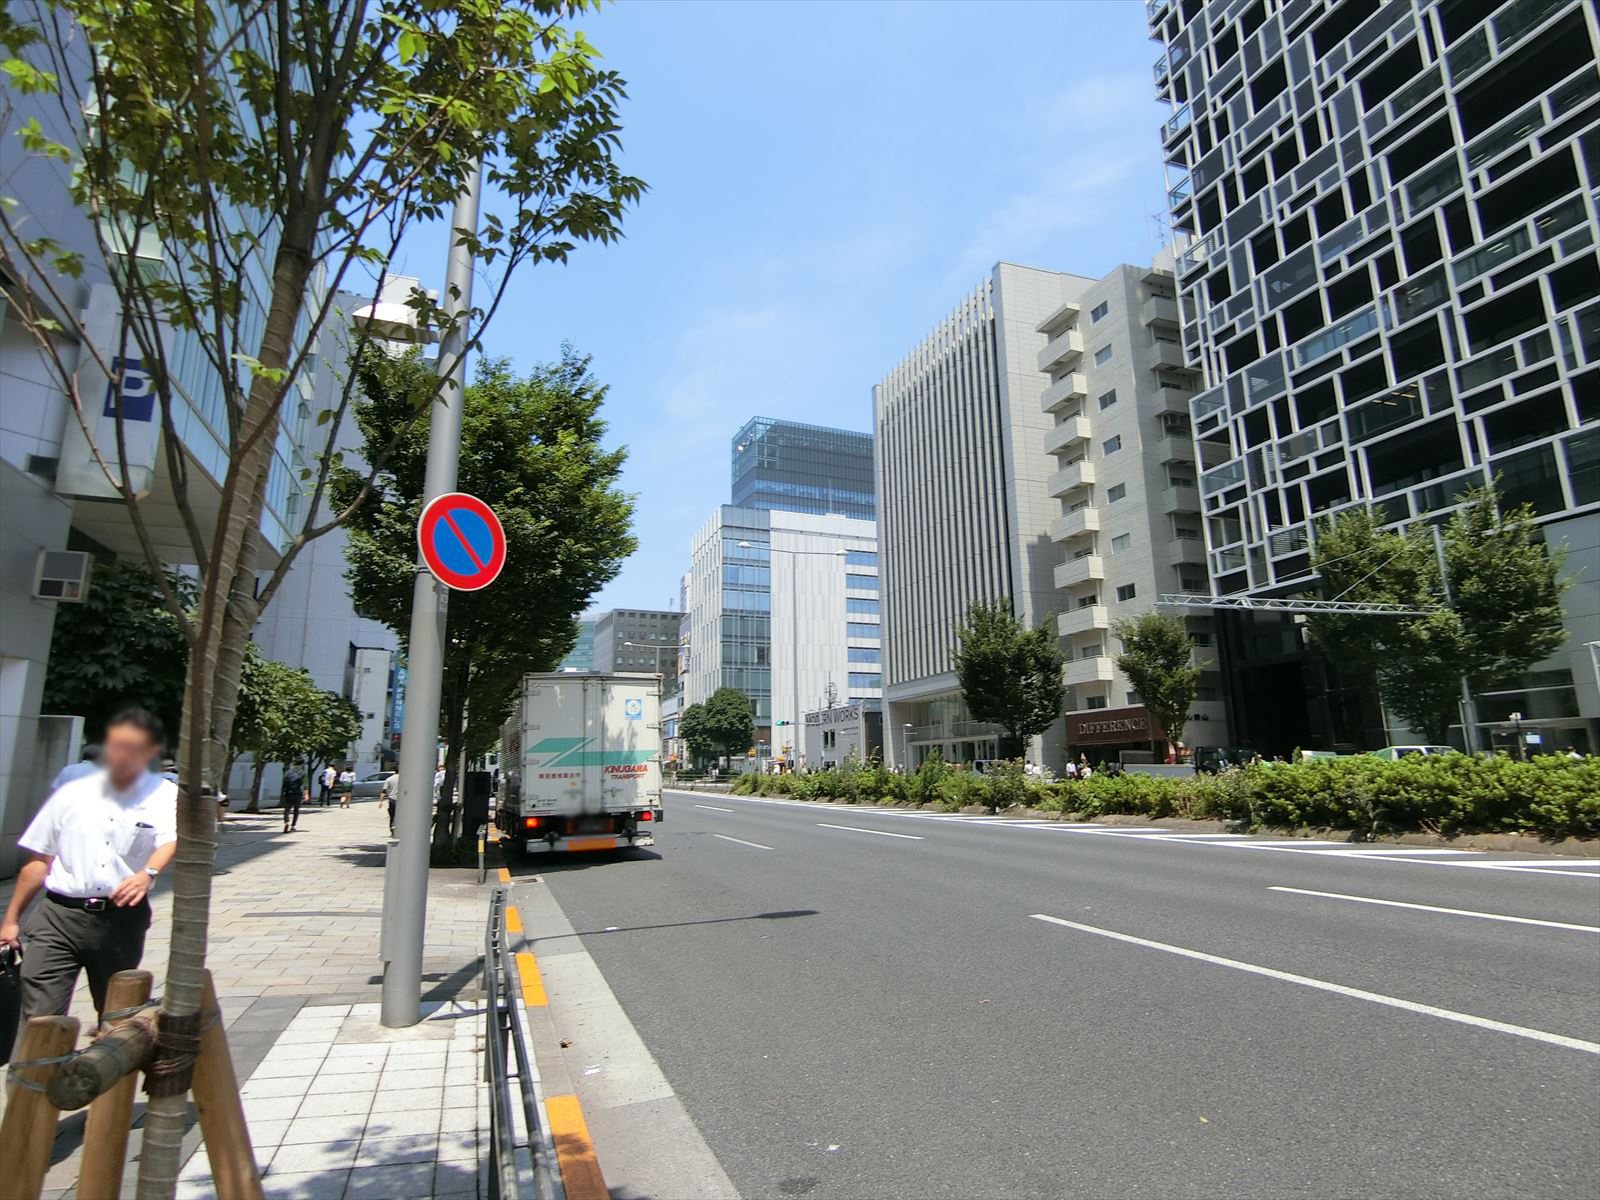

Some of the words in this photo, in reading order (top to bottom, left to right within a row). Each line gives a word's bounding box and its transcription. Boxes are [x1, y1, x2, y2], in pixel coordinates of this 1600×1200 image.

[109, 368, 154, 409] P
[833, 708, 859, 723] WORKS
[1079, 718, 1147, 735] DIFFERENCE
[604, 764, 648, 773] KINUGAWA
